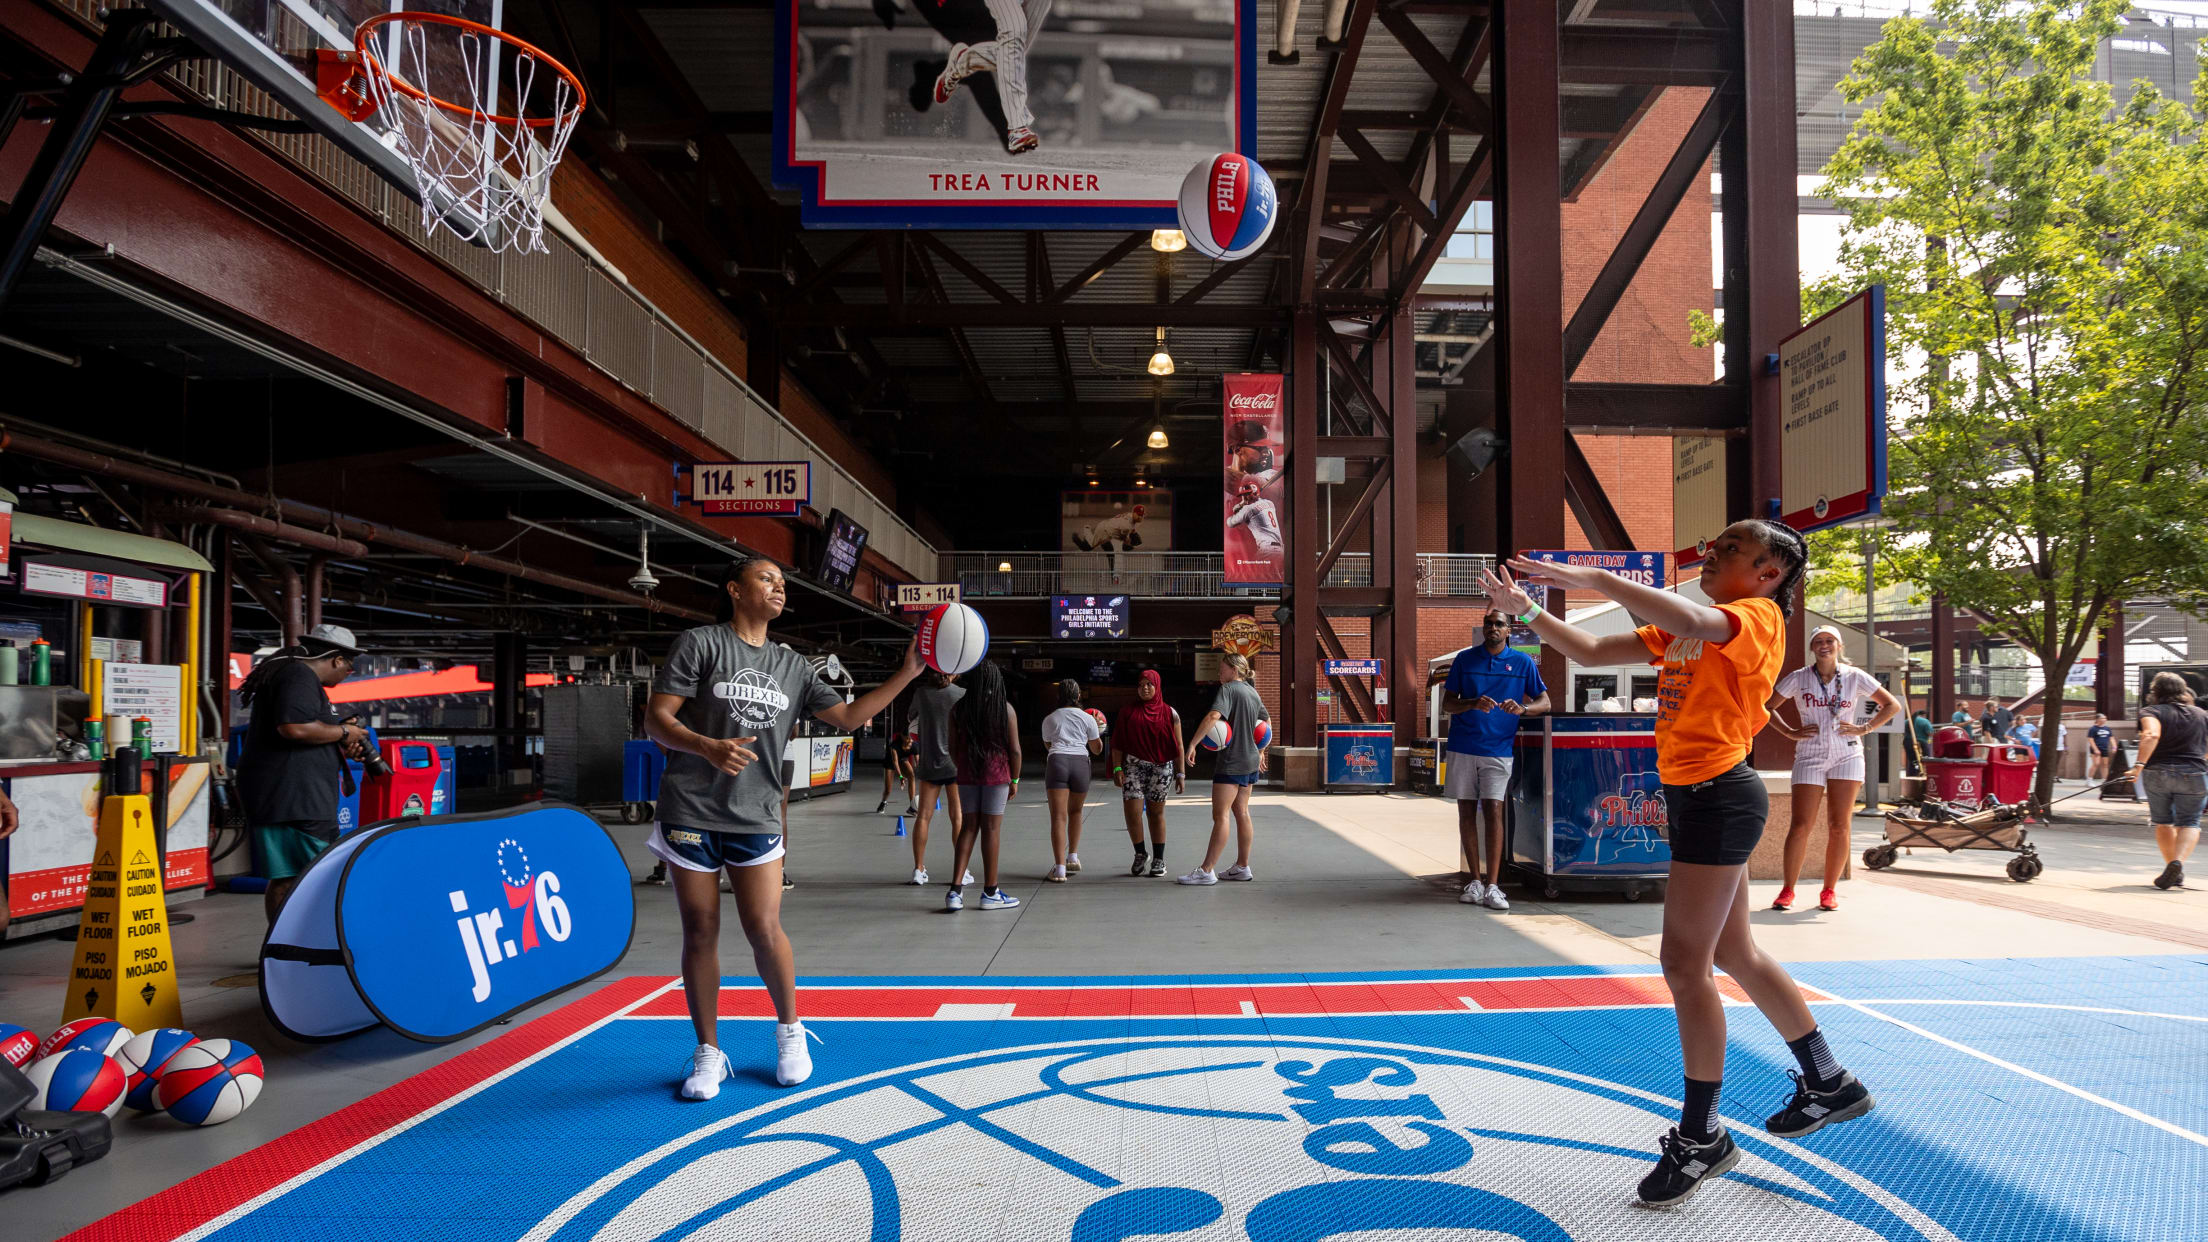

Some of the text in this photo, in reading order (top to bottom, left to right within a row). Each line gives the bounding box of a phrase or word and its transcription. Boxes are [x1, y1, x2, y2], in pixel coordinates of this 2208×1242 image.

[929, 173, 1100, 191] TREA TURNER
[1830, 350, 1847, 367] CLUB
[1817, 379, 1824, 390] TO
[1825, 373, 1836, 386] ALL
[1229, 393, 1277, 409] Coca-Cola
[1791, 397, 1810, 415] LEVELS
[1791, 400, 1839, 431] FIRST BASE GATE
[702, 469, 796, 494] 114 115
[719, 501, 780, 511] SECTIONS
[1268, 511, 1277, 528] 8
[902, 587, 955, 601] 113 114
[1214, 631, 1273, 648] BREWERYTOWN
[725, 684, 784, 707] DREXEL
[1601, 795, 1668, 826] Philli
[62, 874, 84, 885] THE
[92, 870, 117, 882] CAUTION
[127, 868, 155, 881] CAUTION
[31, 892, 47, 901] OF
[51, 887, 72, 898] THE
[90, 887, 116, 898] CUIDADO
[127, 884, 157, 898] CUIDADO
[91, 911, 110, 923] WET
[132, 908, 155, 921] WET
[84, 927, 113, 939] FLOOR
[127, 923, 161, 938] FLOOR
[85, 952, 106, 964] PISO
[134, 947, 158, 961] PISO
[75, 968, 112, 980] MOJADO
[126, 960, 168, 979] MOJADO
